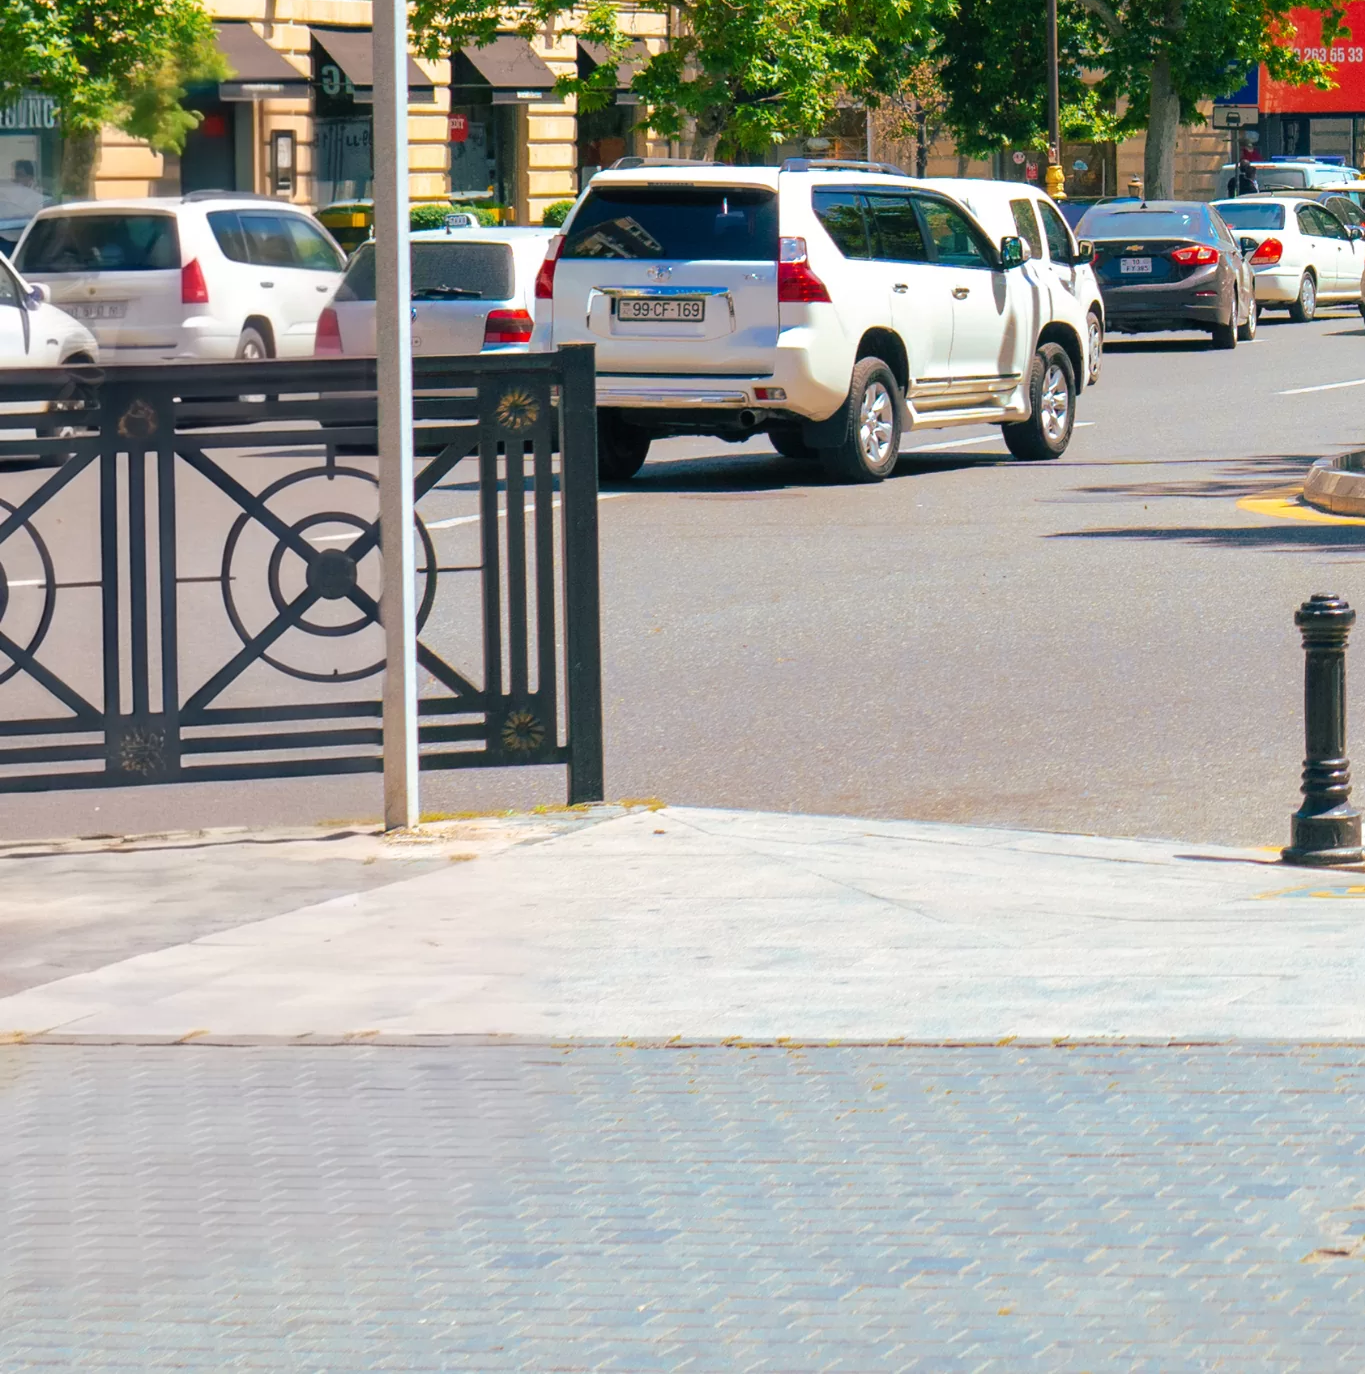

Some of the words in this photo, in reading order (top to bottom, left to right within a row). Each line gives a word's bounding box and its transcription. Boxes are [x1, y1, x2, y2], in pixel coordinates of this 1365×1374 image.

[1330, 47, 1345, 63] 55
[1348, 47, 1364, 62] 33
[633, 302, 700, 317] 99-CF-169
